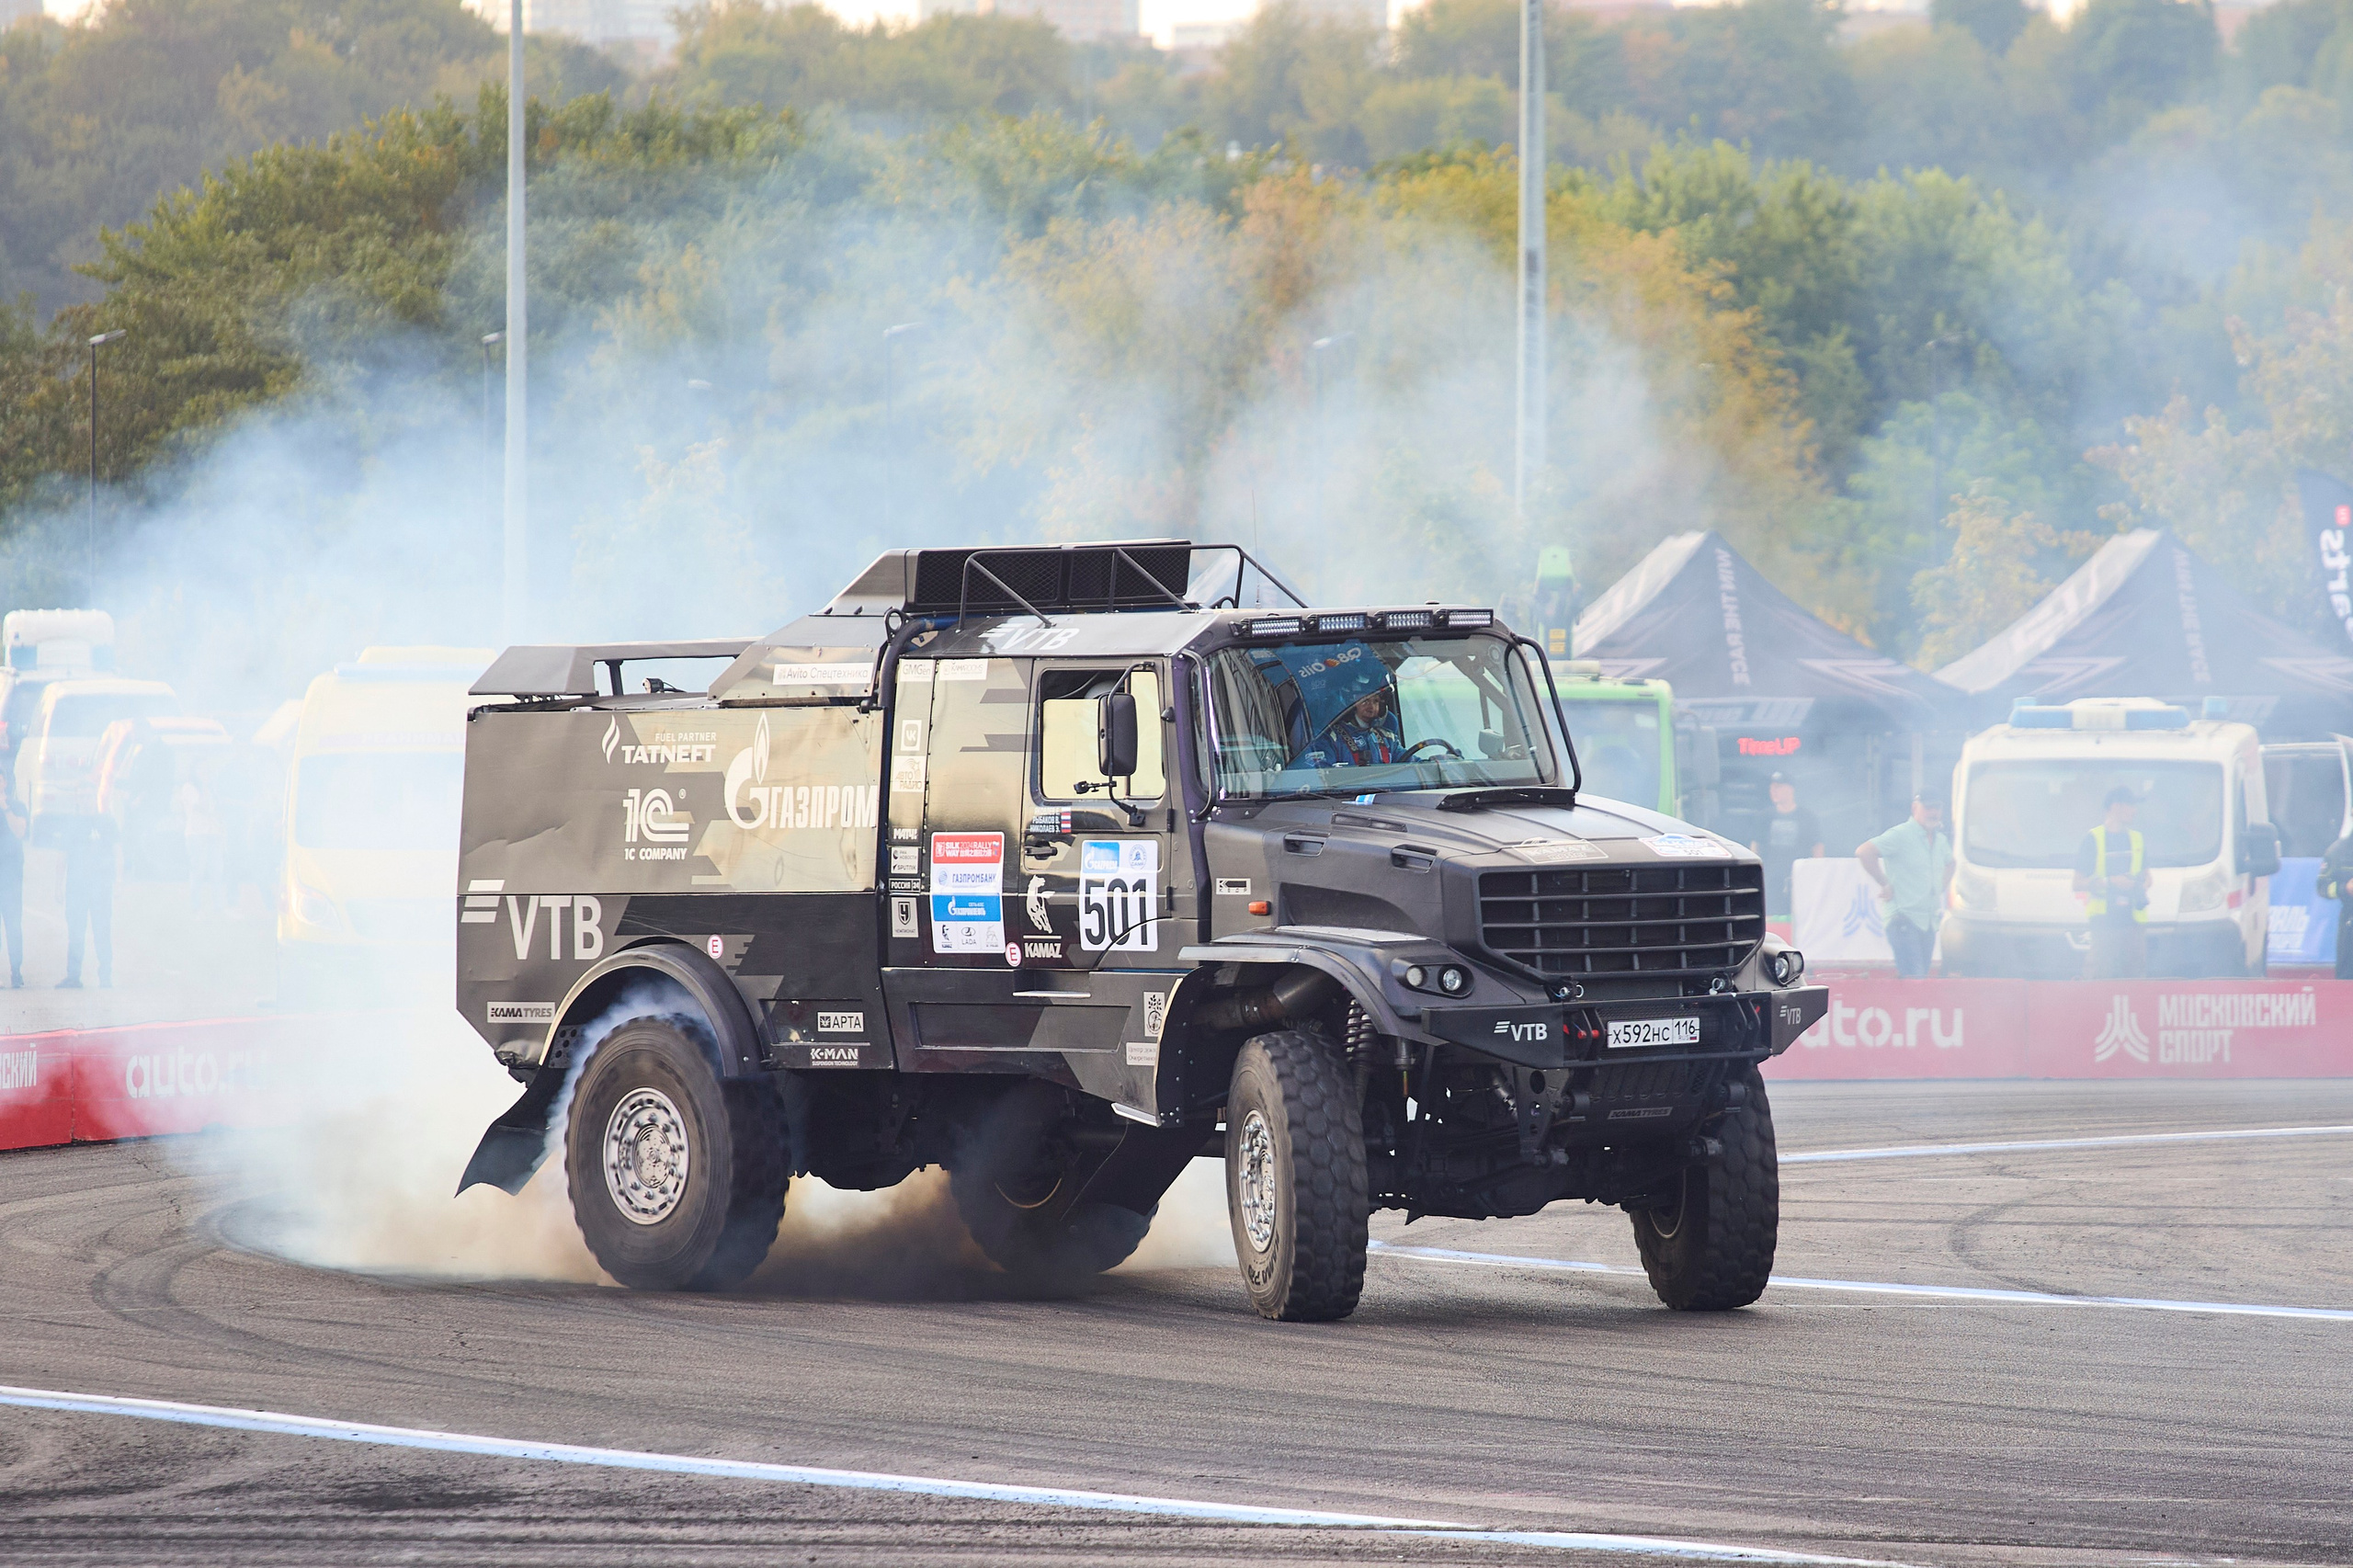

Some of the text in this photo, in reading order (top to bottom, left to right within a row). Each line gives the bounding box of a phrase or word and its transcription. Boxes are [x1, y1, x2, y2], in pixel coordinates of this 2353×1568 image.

[1001, 628, 1080, 650] VTB
[786, 666, 869, 680] Avito Спецтехника
[655, 732, 717, 742] FUEL PARTNER
[906, 730, 917, 741] VK
[621, 744, 716, 764] TATNEFT
[769, 785, 879, 828] ГАЗПРОМ
[639, 848, 688, 860] COMPANY
[1084, 878, 1148, 946] 501
[506, 894, 604, 960] VTB
[712, 939, 718, 954] E
[1010, 947, 1017, 961] E
[1024, 942, 1062, 958] KAMAZ
[490, 1007, 552, 1017] KAMA TYRES
[1786, 1007, 1802, 1025] VTB
[2159, 986, 2316, 1028] МОСКОВСКИЙ
[1510, 1023, 1547, 1041] VTB
[1675, 1020, 1695, 1035] 116
[2159, 1029, 2234, 1063] СПОРТ
[0, 1042, 37, 1090] СКИЙ
